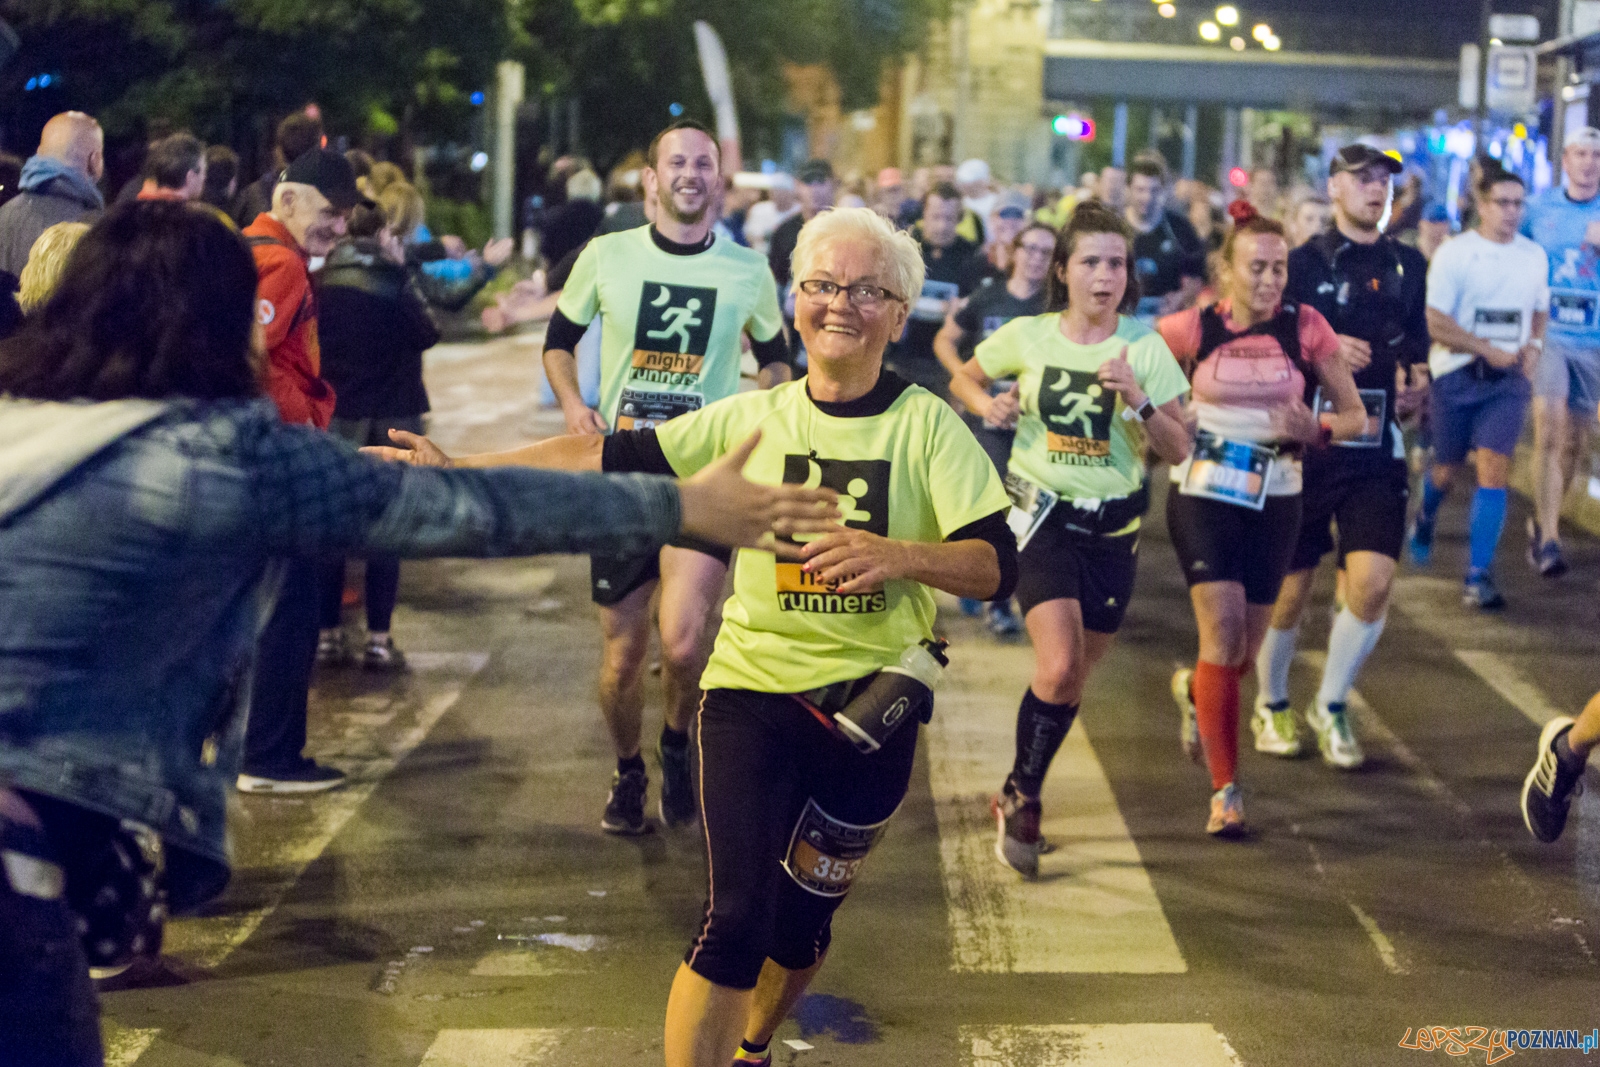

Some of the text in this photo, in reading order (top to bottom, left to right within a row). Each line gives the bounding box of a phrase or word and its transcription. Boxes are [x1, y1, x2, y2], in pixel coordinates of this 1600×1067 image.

[645, 352, 692, 371] night
[630, 367, 699, 386] runners
[778, 592, 886, 614] runners
